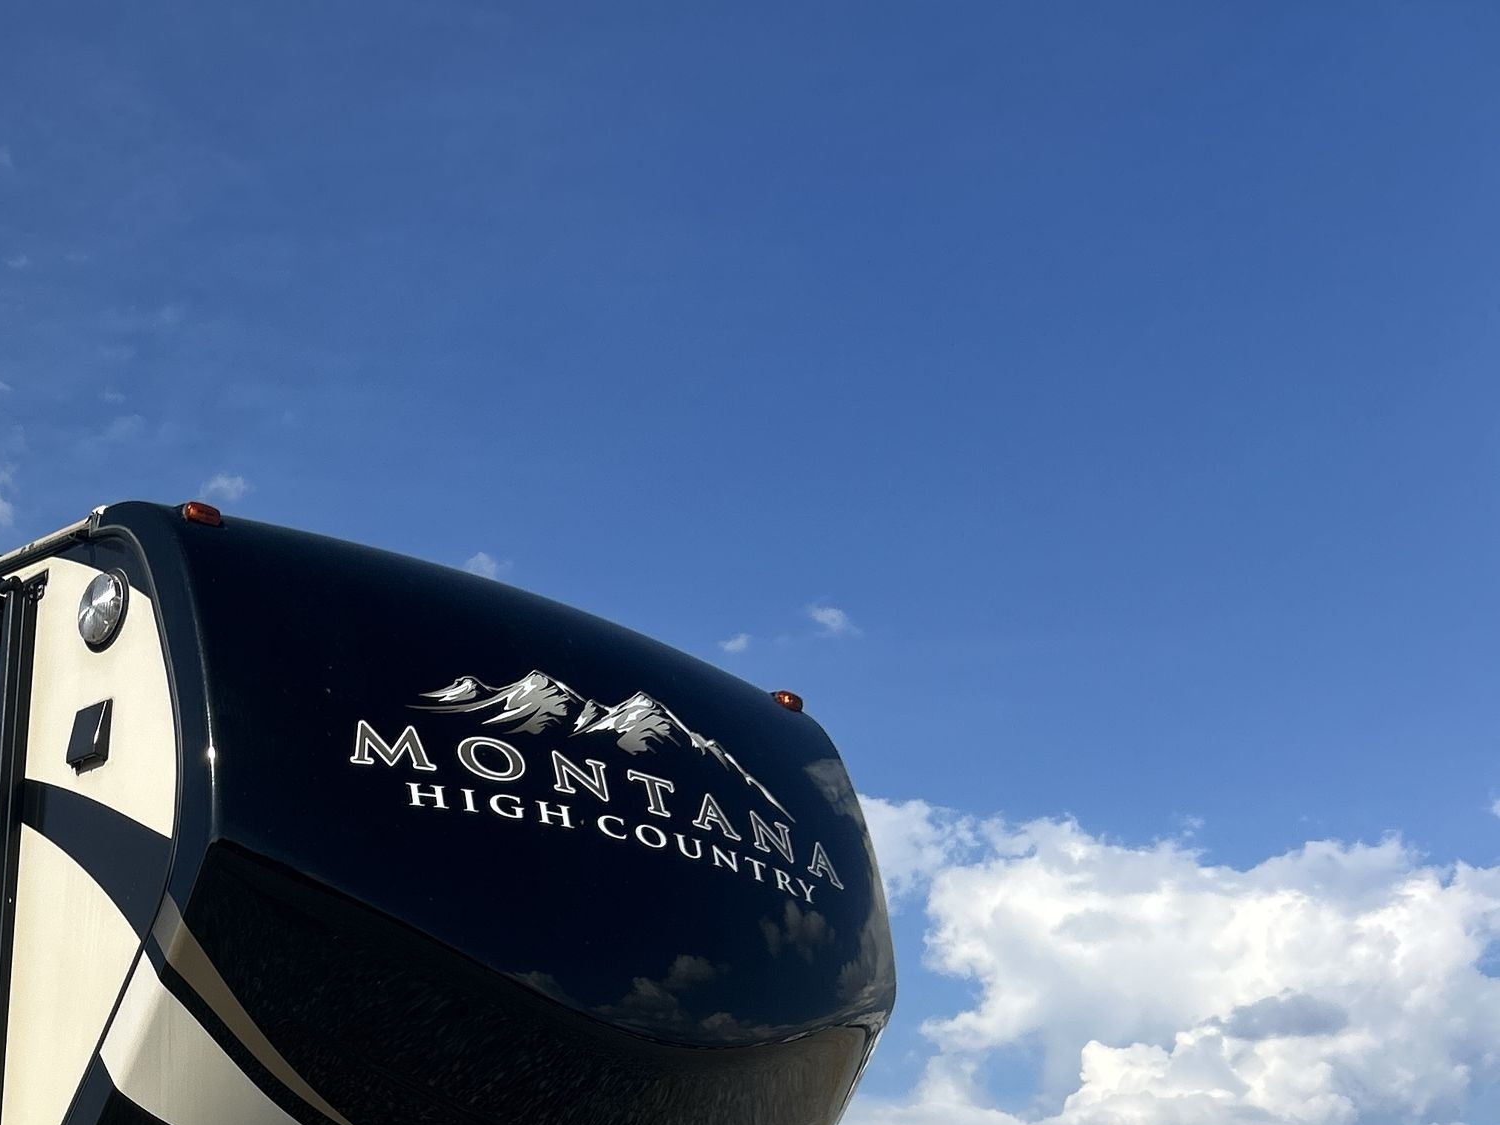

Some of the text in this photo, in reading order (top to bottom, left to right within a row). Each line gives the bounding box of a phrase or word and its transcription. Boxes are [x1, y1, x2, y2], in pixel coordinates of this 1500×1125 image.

[350, 720, 844, 891] MONTANA
[405, 782, 815, 904] HIGH COUNTRY
